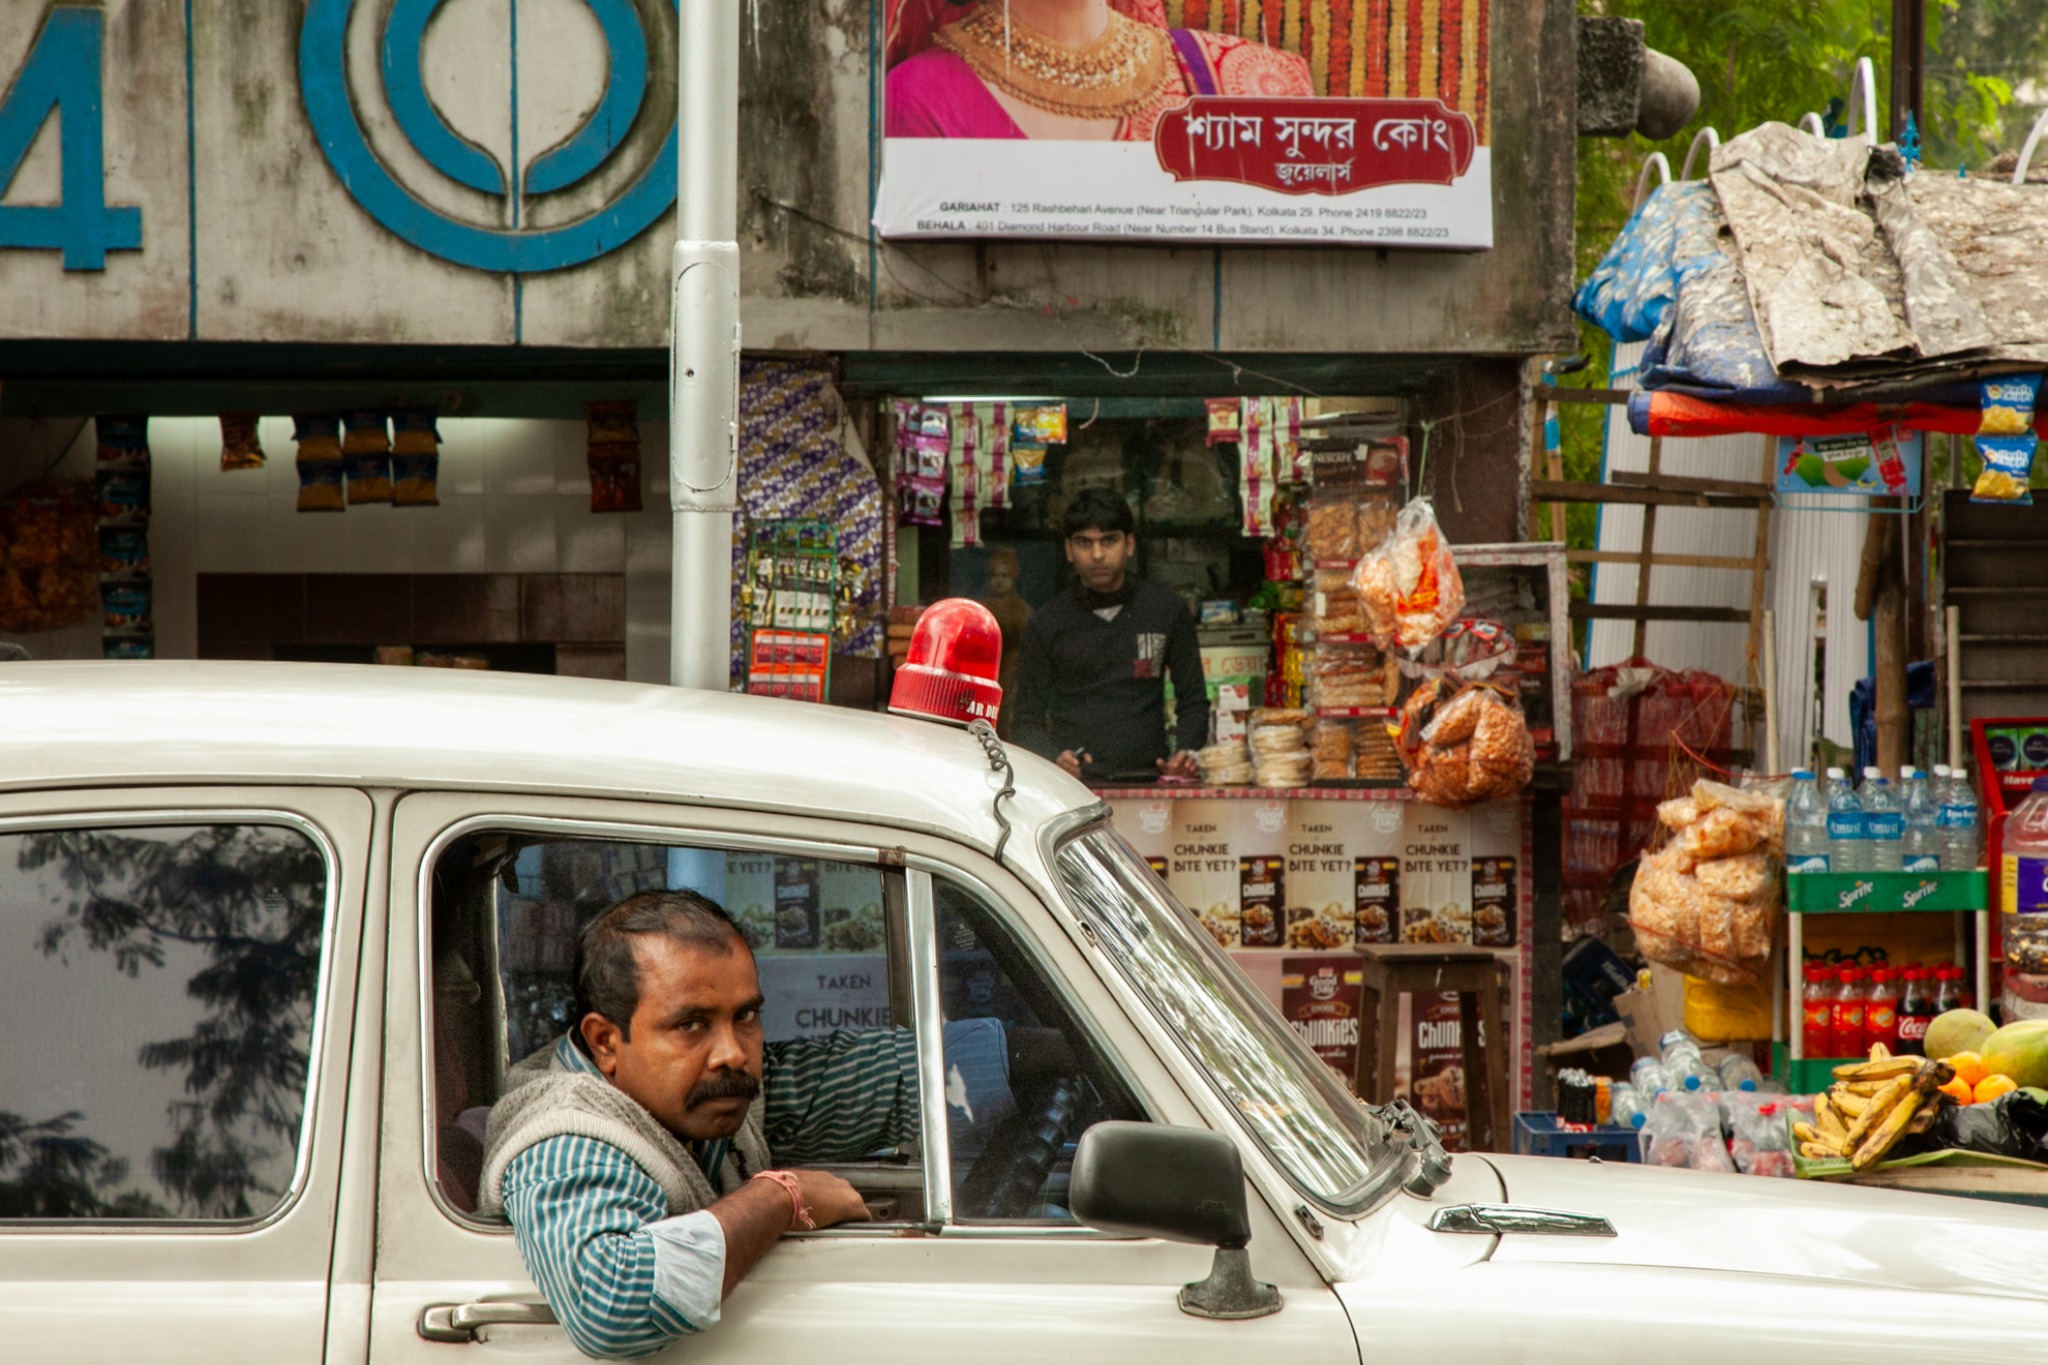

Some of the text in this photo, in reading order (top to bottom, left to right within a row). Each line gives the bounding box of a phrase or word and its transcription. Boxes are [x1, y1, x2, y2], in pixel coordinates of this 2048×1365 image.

[1183, 112, 1449, 159] শ্যাম সুন্দর কোং
[1275, 158, 1355, 185] জুয়েলার্স
[940, 202, 1000, 213] GARIAHAT
[1011, 204, 1030, 214] 125
[1033, 203, 1092, 215] Rashbehari
[1095, 205, 1134, 215] Avenue
[1137, 205, 1165, 217] (Near
[1168, 206, 1221, 219] Triangular
[1258, 207, 1296, 218] Kolkata
[1319, 208, 1352, 218] Phone
[1356, 208, 1382, 219] 2419
[1385, 208, 1427, 220] 8822/23
[917, 220, 965, 231] BEHALA
[975, 222, 995, 232] 401
[998, 222, 1045, 233] Diamond
[1047, 222, 1090, 233] Harbour
[1093, 222, 1121, 233] Road
[1124, 223, 1153, 236] (Near
[1155, 223, 1197, 234] Number
[1202, 225, 1213, 234] 14
[1216, 225, 1237, 235] Bus
[1280, 226, 1318, 236] Kolkata
[1341, 227, 1374, 237] Phone
[1378, 227, 1404, 238] 2398
[1407, 228, 1449, 239] 8822/23
[1186, 824, 1216, 833] TAKEN
[1301, 824, 1332, 833] TAKEN
[1417, 824, 1448, 833] TAKEN
[1174, 844, 1229, 856] CHUNKIE
[1289, 844, 1345, 856] CHUNKIE
[1405, 844, 1461, 856] CHUNKIE
[1174, 860, 1236, 872] BITE YET?
[1289, 860, 1352, 872] BITE YET?
[1405, 860, 1469, 872] BITE YET?
[1838, 880, 1873, 909] Sprite
[1902, 880, 1938, 909] Sprite
[817, 974, 871, 989] TAKEN
[795, 1008, 890, 1028] CHUNKIE
